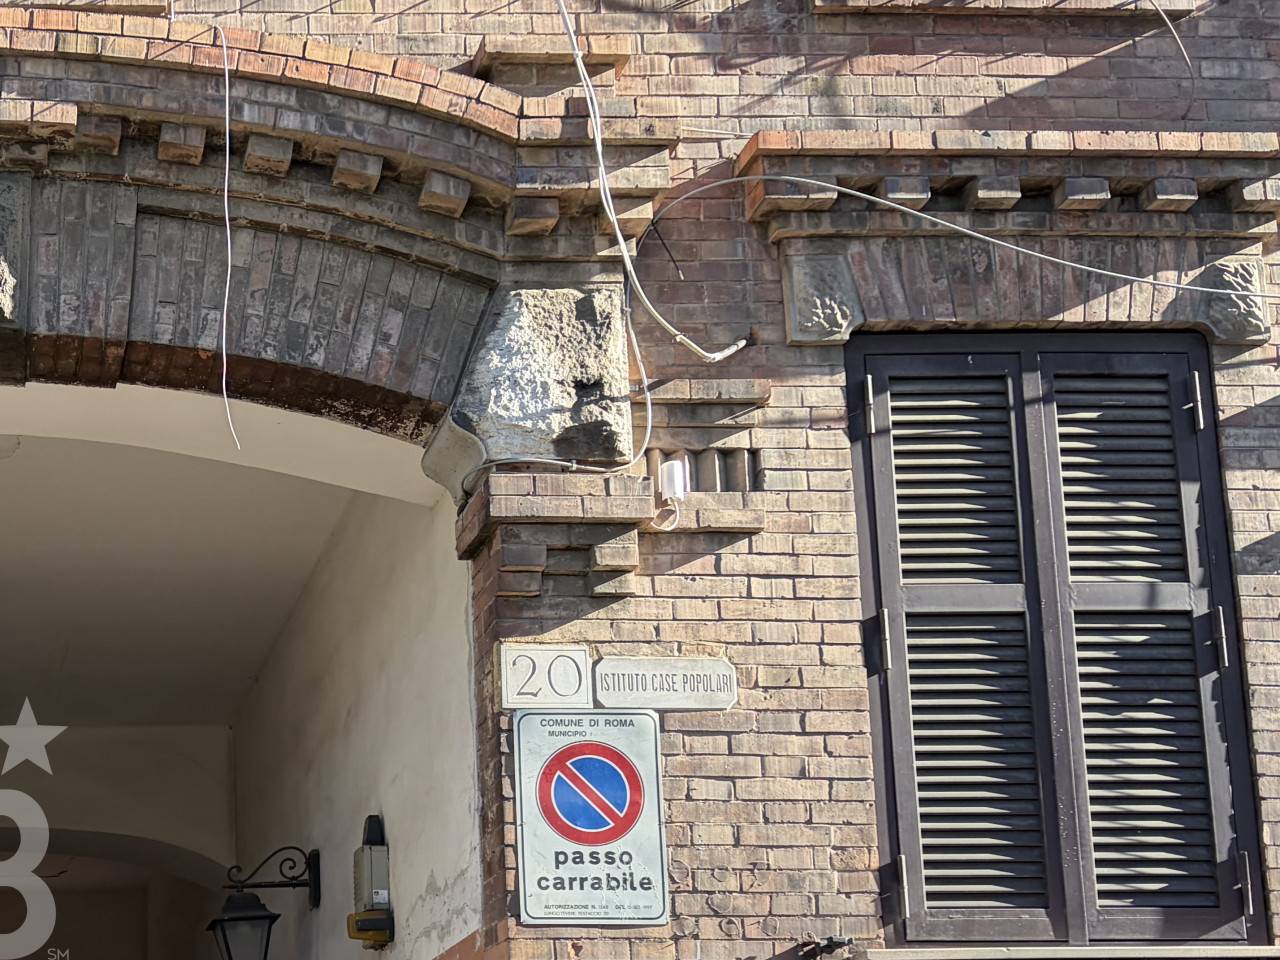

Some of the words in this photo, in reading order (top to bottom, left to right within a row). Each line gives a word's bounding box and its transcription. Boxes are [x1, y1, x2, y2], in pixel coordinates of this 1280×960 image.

[512, 655, 582, 697] 20
[600, 673, 647, 693] ISTITUTO
[652, 673, 677, 693] CASE
[683, 674, 732, 693] POPOLARI
[540, 719, 584, 728] COMUNE
[589, 719, 599, 728] DI
[604, 719, 635, 728] ROMA
[548, 730, 587, 738] MUNICIPIO
[554, 850, 633, 869] passo
[537, 872, 653, 891] carrabile
